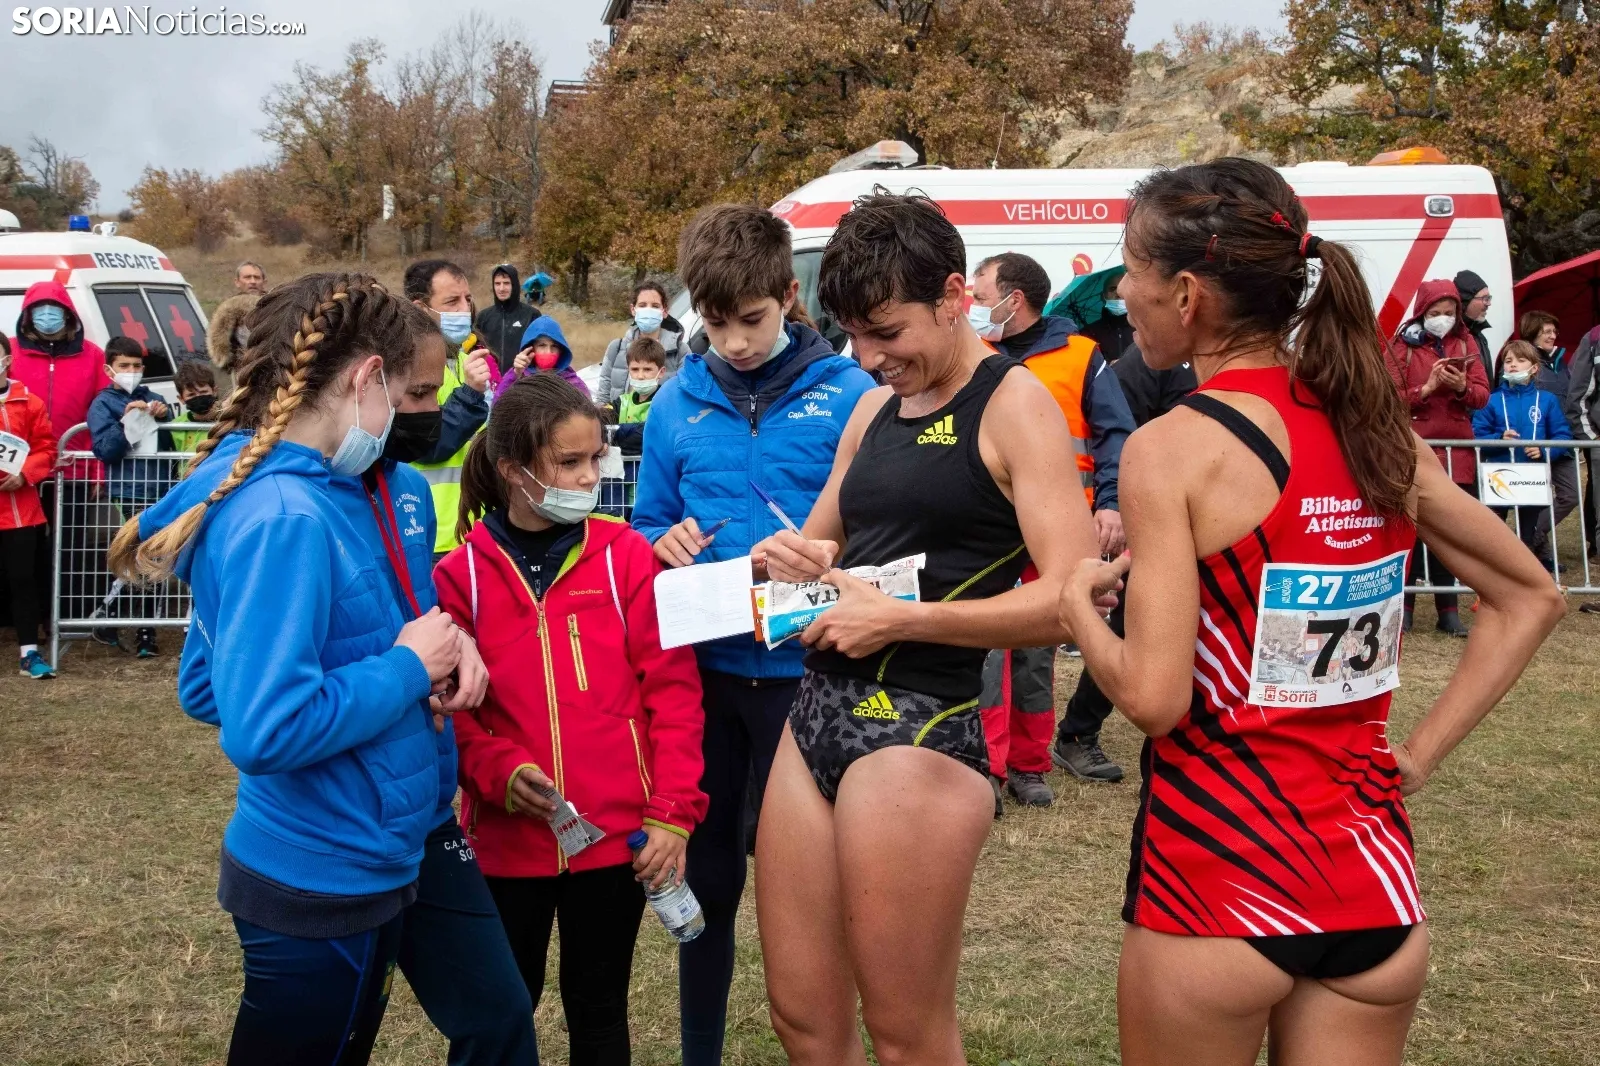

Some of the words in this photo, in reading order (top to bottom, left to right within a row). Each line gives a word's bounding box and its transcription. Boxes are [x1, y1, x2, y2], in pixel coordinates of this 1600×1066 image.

[1002, 200, 1109, 221] VEHÍCULO
[94, 252, 160, 271] RESCATE
[801, 391, 829, 401] SORIA
[917, 432, 958, 445] adidas
[1299, 496, 1363, 516] Bilbao
[1304, 513, 1385, 534] Atletismo
[1349, 571, 1376, 585] CAMPO
[568, 588, 604, 597] Quechua
[1297, 574, 1344, 605] 27
[1306, 611, 1381, 678] 73
[1278, 689, 1318, 704] Soria
[852, 706, 901, 720] adidas
